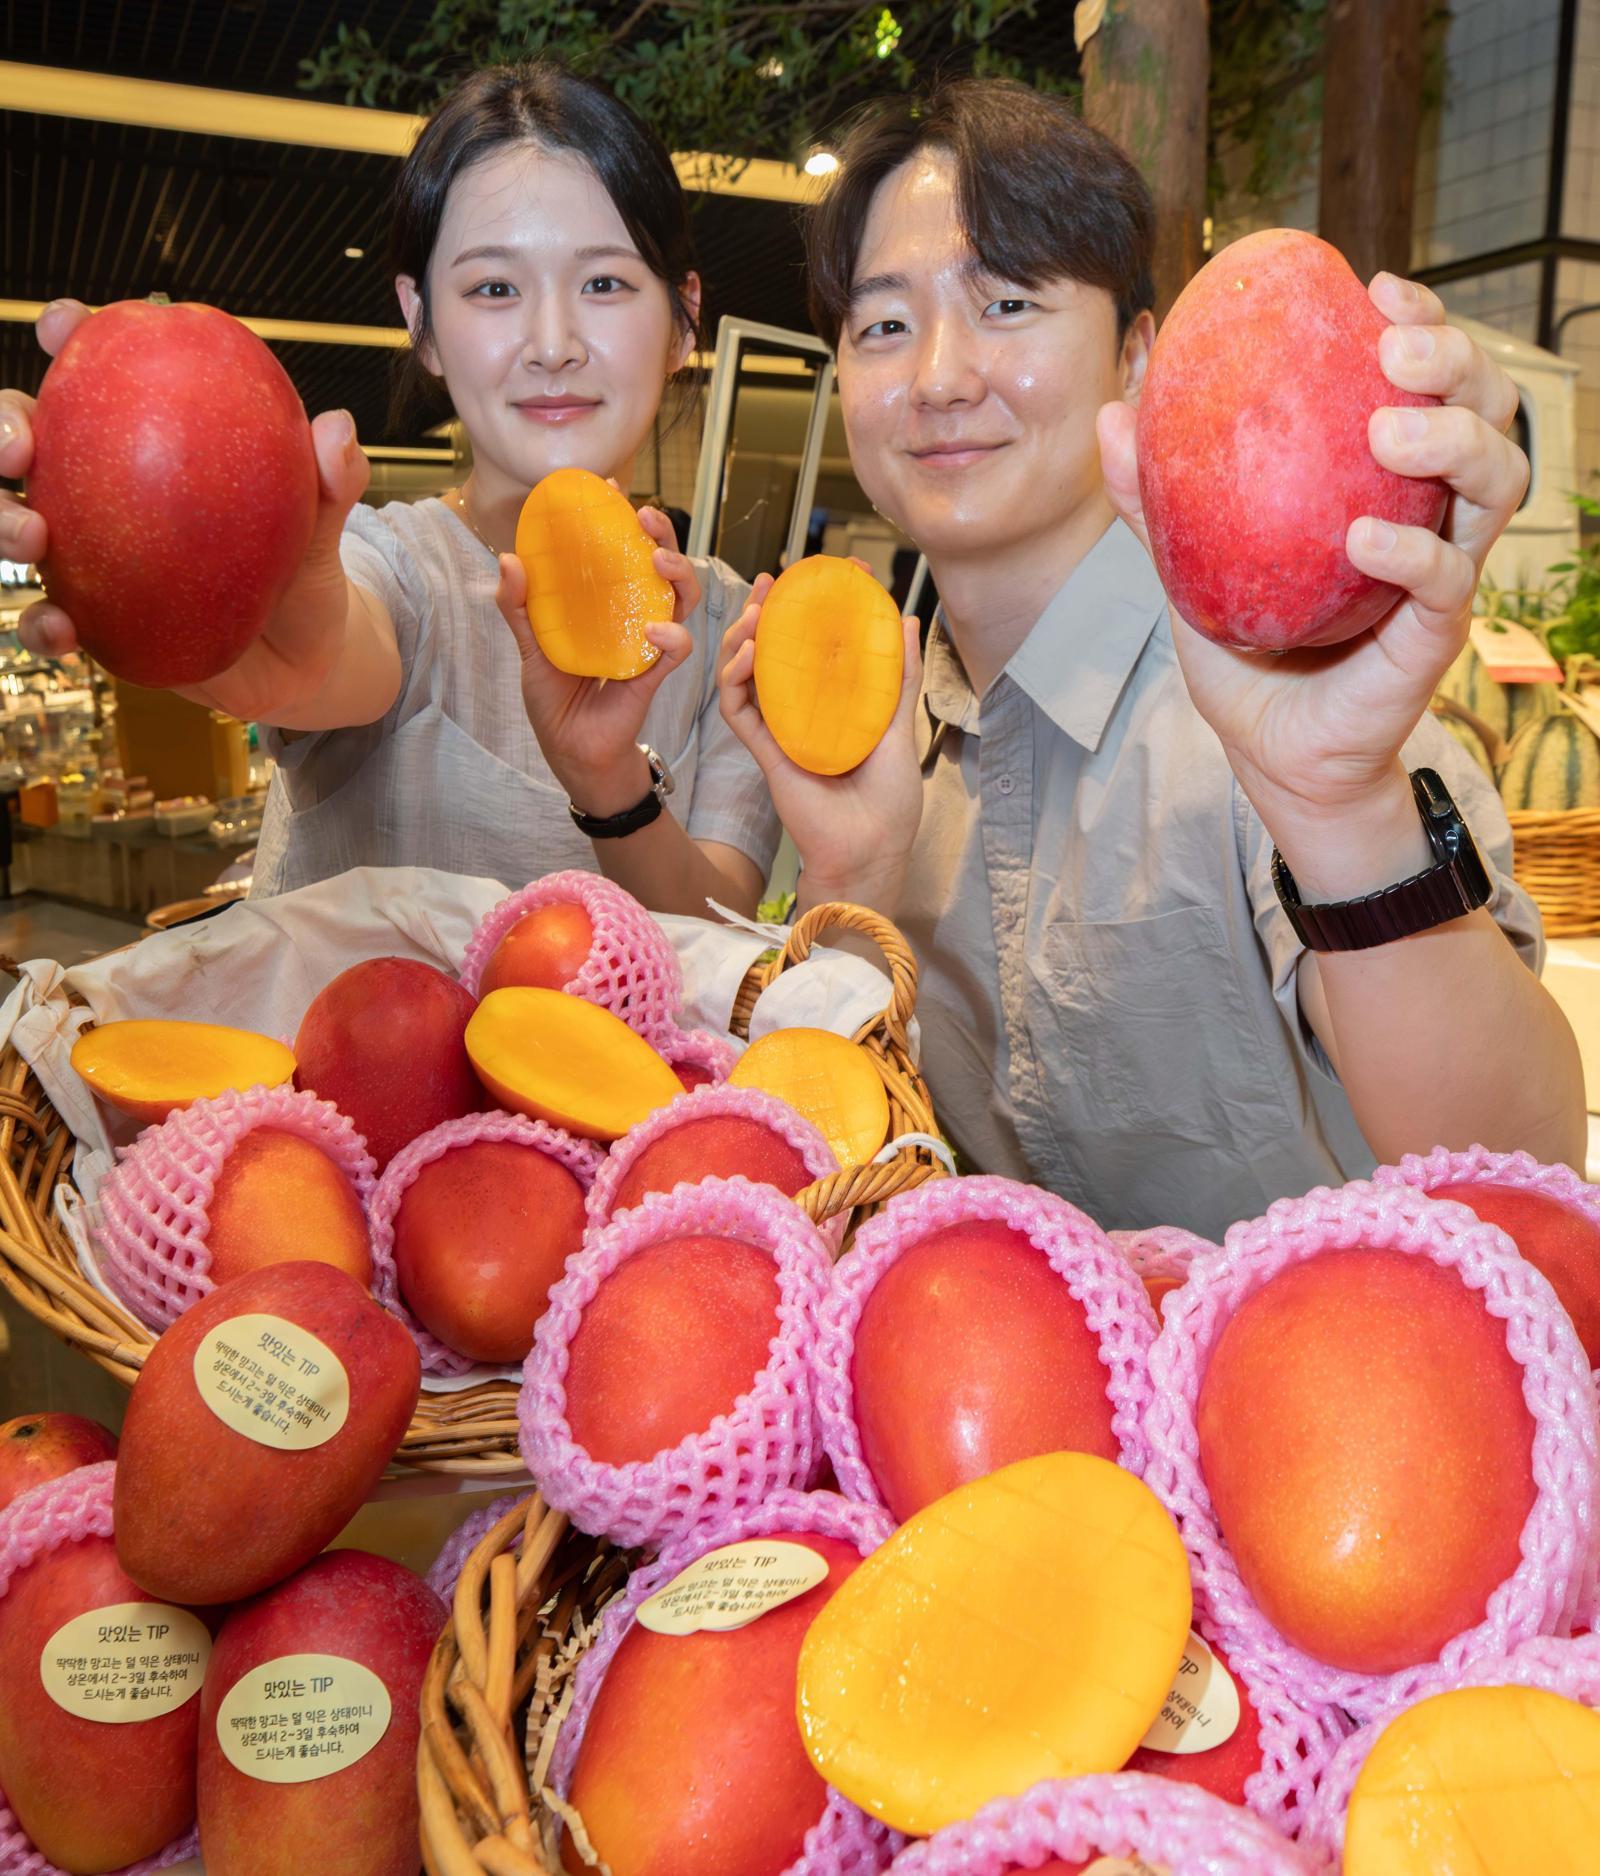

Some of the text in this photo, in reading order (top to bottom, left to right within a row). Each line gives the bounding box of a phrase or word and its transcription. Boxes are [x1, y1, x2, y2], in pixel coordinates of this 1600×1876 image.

[258, 1332, 320, 1376] 맛있는 TIP
[216, 1341, 239, 1362] 딱딱한
[238, 1355, 264, 1379] 망고는
[278, 1380, 296, 1399] 익은
[296, 1394, 331, 1422] 상태이니
[213, 1360, 312, 1428] 상온에서 2~3일 후숙하여
[216, 1380, 290, 1435] 드시는게 좋습니다.
[703, 1556, 777, 1572] 맛있는 TIP
[98, 1625, 169, 1643] 맛있는 TIP
[56, 1652, 199, 1670] 딱딱한 망고는 덜 익은 상태이니
[67, 1669, 187, 1686] 상온에서 2~3일 후숙하여
[265, 1677, 333, 1700] 맛있는 TIP
[83, 1686, 172, 1701] 드시는게 좋습니다.
[230, 1705, 372, 1730] 딱딱한 망고는 덜 익은 상태이니
[1161, 1706, 1185, 1729] 하여
[1167, 1691, 1211, 1727] 상태이니
[241, 1723, 359, 1746] 상온에서 2~3일 후숙하여
[256, 1741, 344, 1760] 드시는게 좋습니다.
